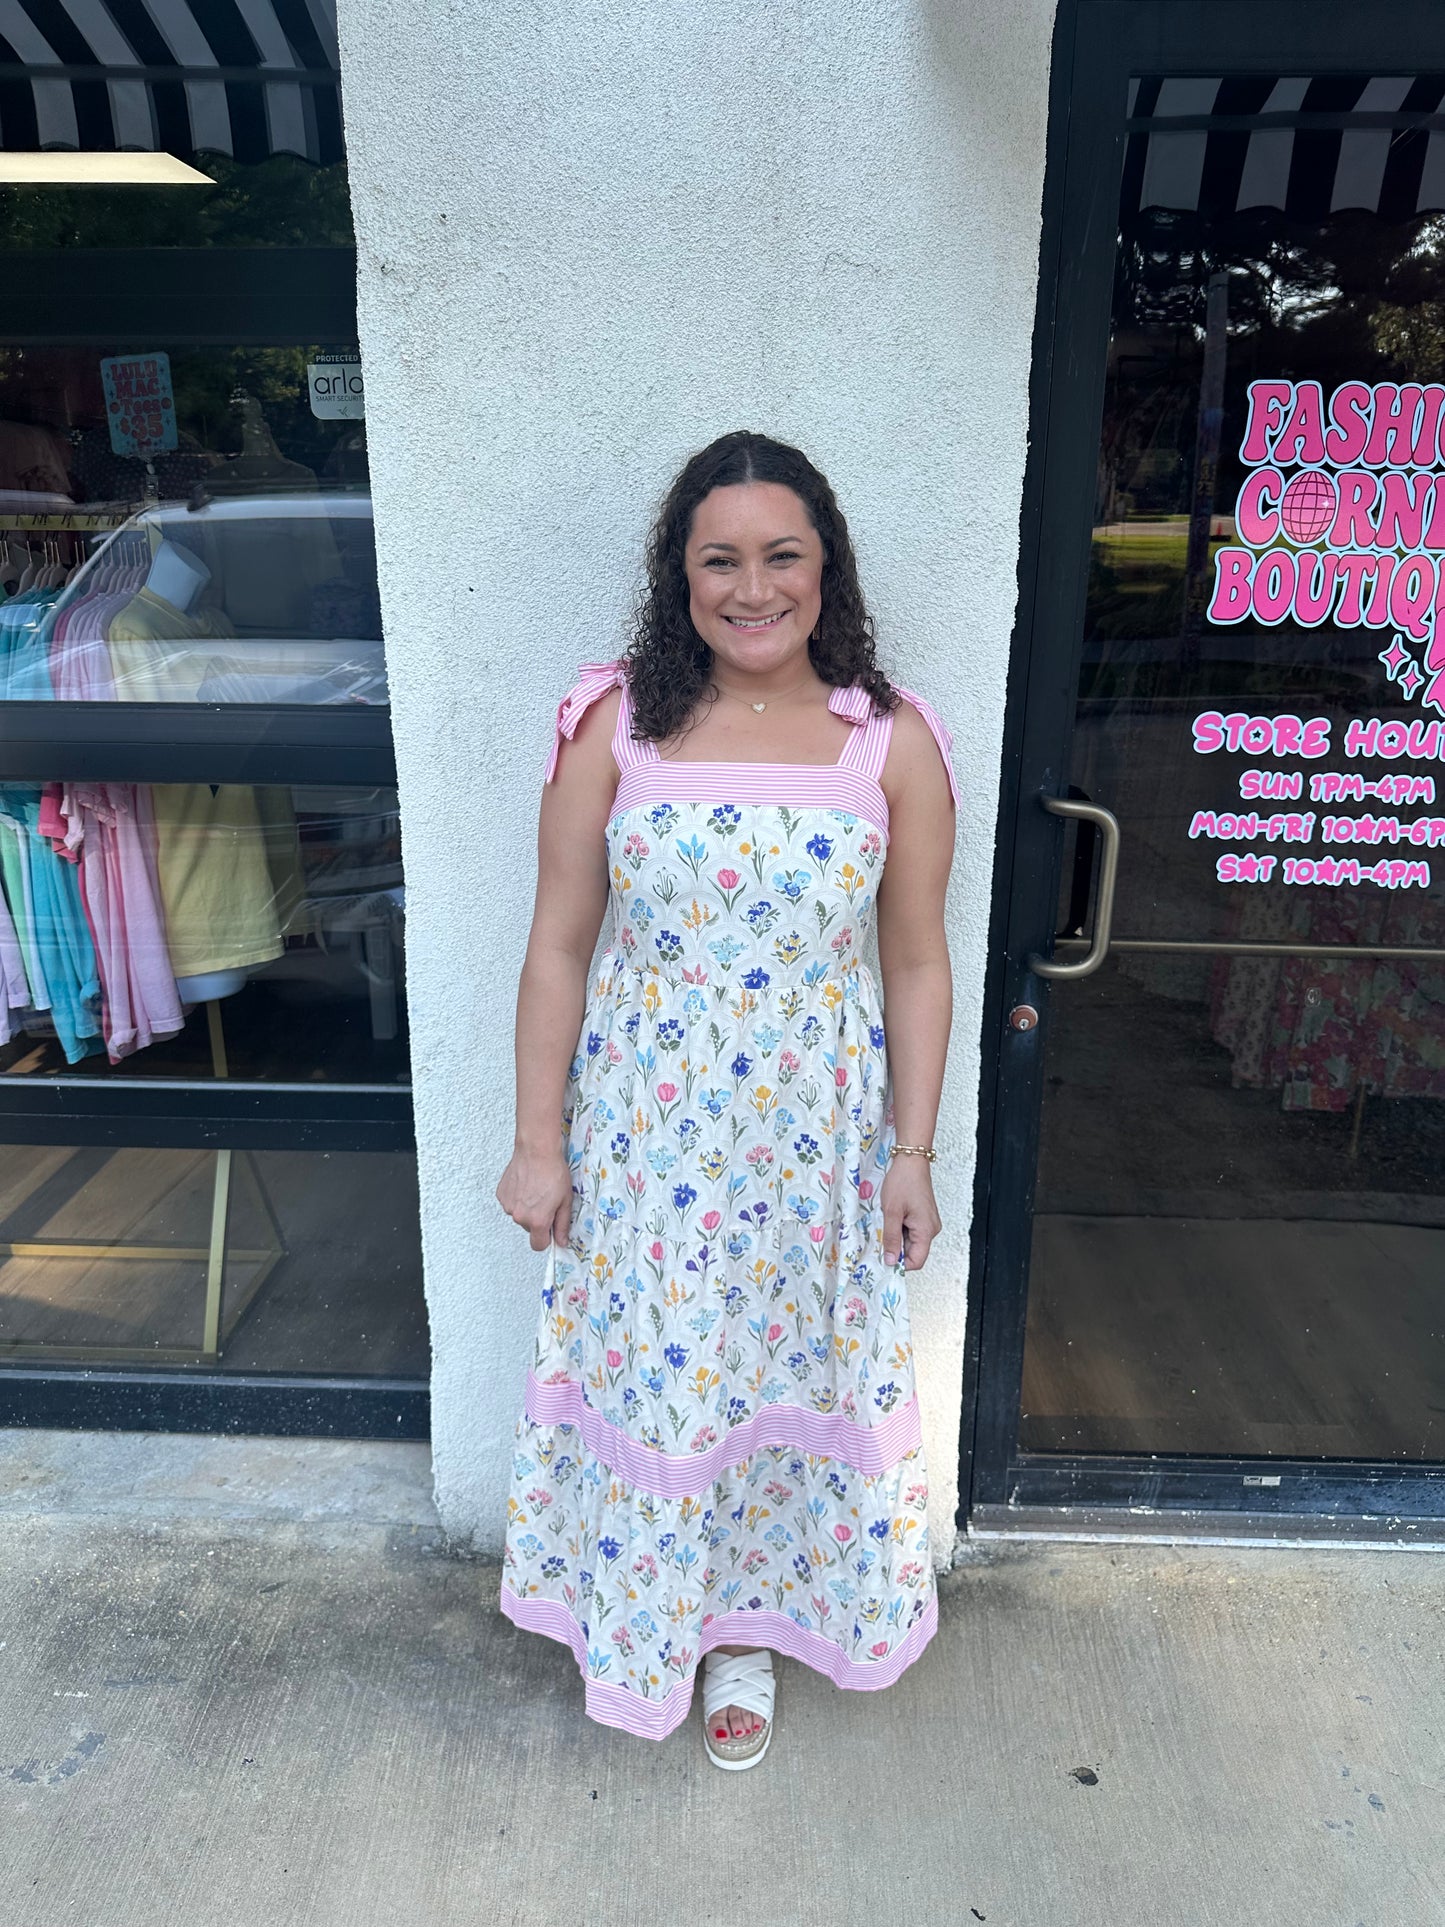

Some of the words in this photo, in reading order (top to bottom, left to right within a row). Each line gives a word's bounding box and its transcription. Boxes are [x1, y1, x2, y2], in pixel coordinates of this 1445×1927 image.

[110, 360, 158, 381] LULU
[315, 354, 359, 362] PROTECTED
[116, 377, 160, 399] MAC
[314, 368, 364, 394] arlo
[120, 413, 164, 440] $35
[1240, 380, 1445, 469] FASHI
[1207, 547, 1445, 643] BOUTIQ
[1192, 711, 1331, 759] STORE
[1345, 719, 1445, 762] HOU
[1240, 770, 1303, 800] SUN
[1310, 773, 1435, 805] 1PM-4PM
